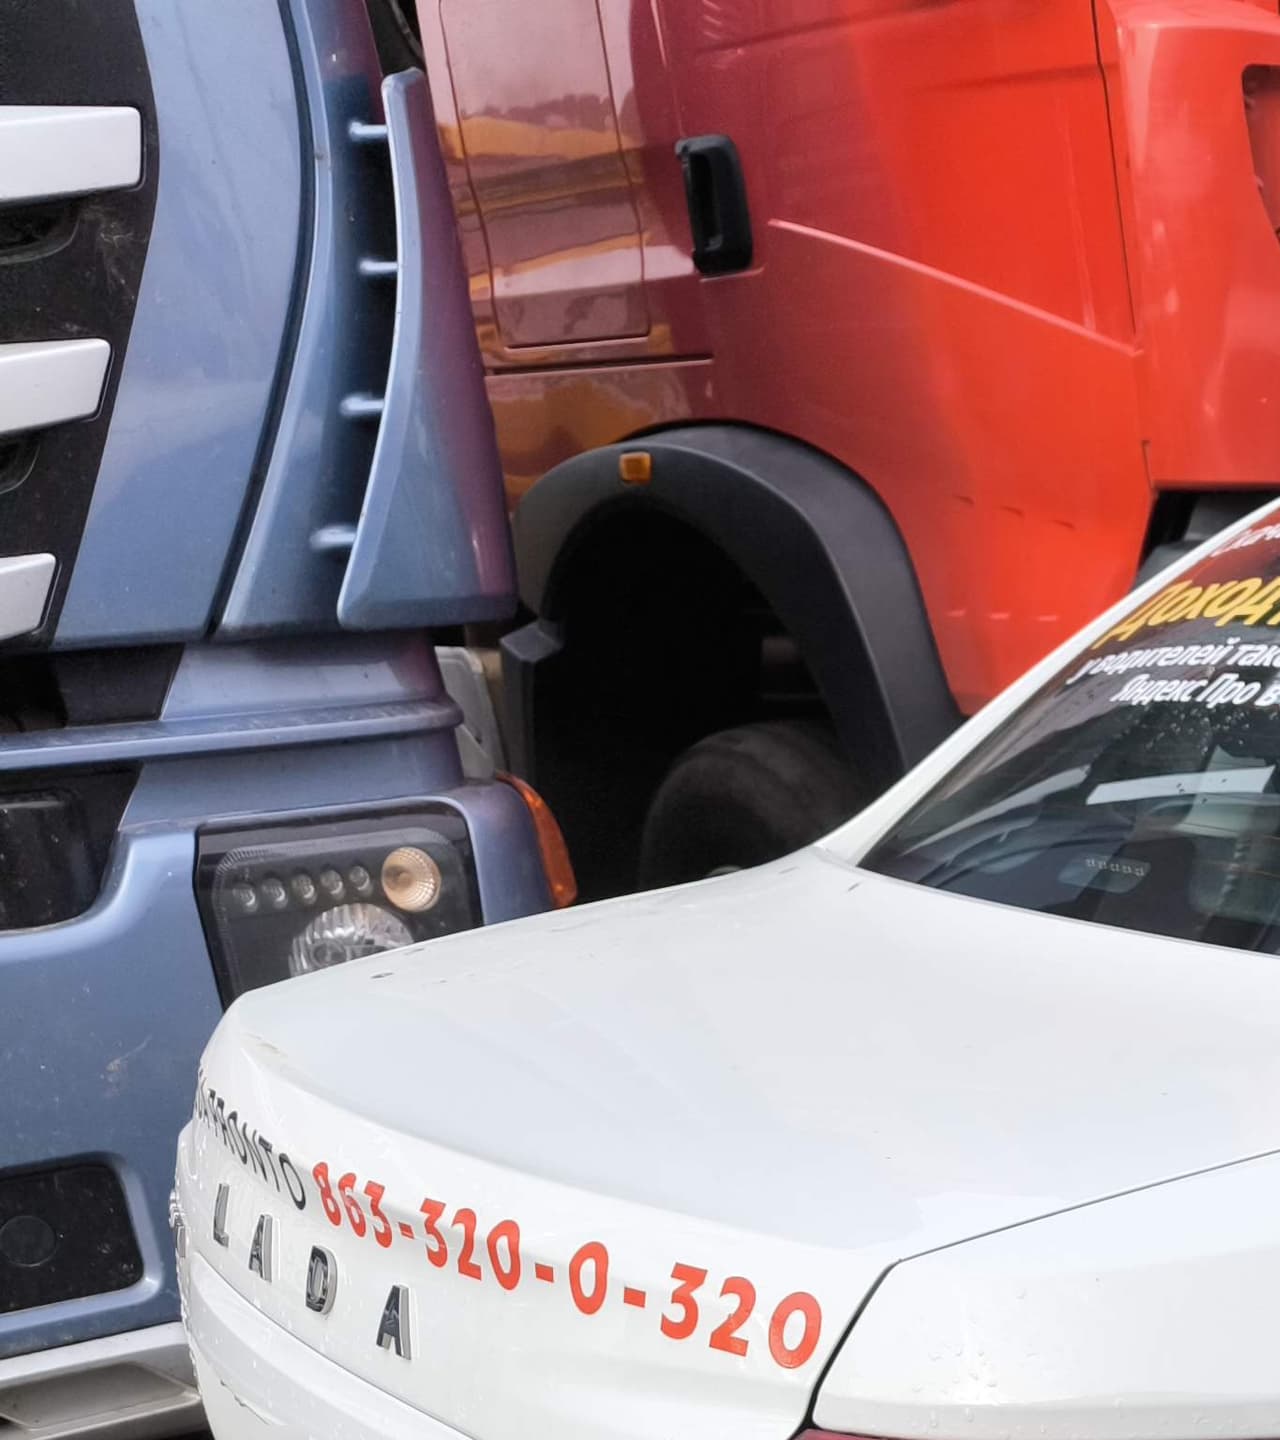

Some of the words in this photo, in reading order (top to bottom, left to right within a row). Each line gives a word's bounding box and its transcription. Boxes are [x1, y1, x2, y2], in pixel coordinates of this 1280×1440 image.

[1198, 673, 1261, 709] Про
[212, 1183, 412, 1361] LADA
[312, 1161, 822, 1369] 863-320-0-320
